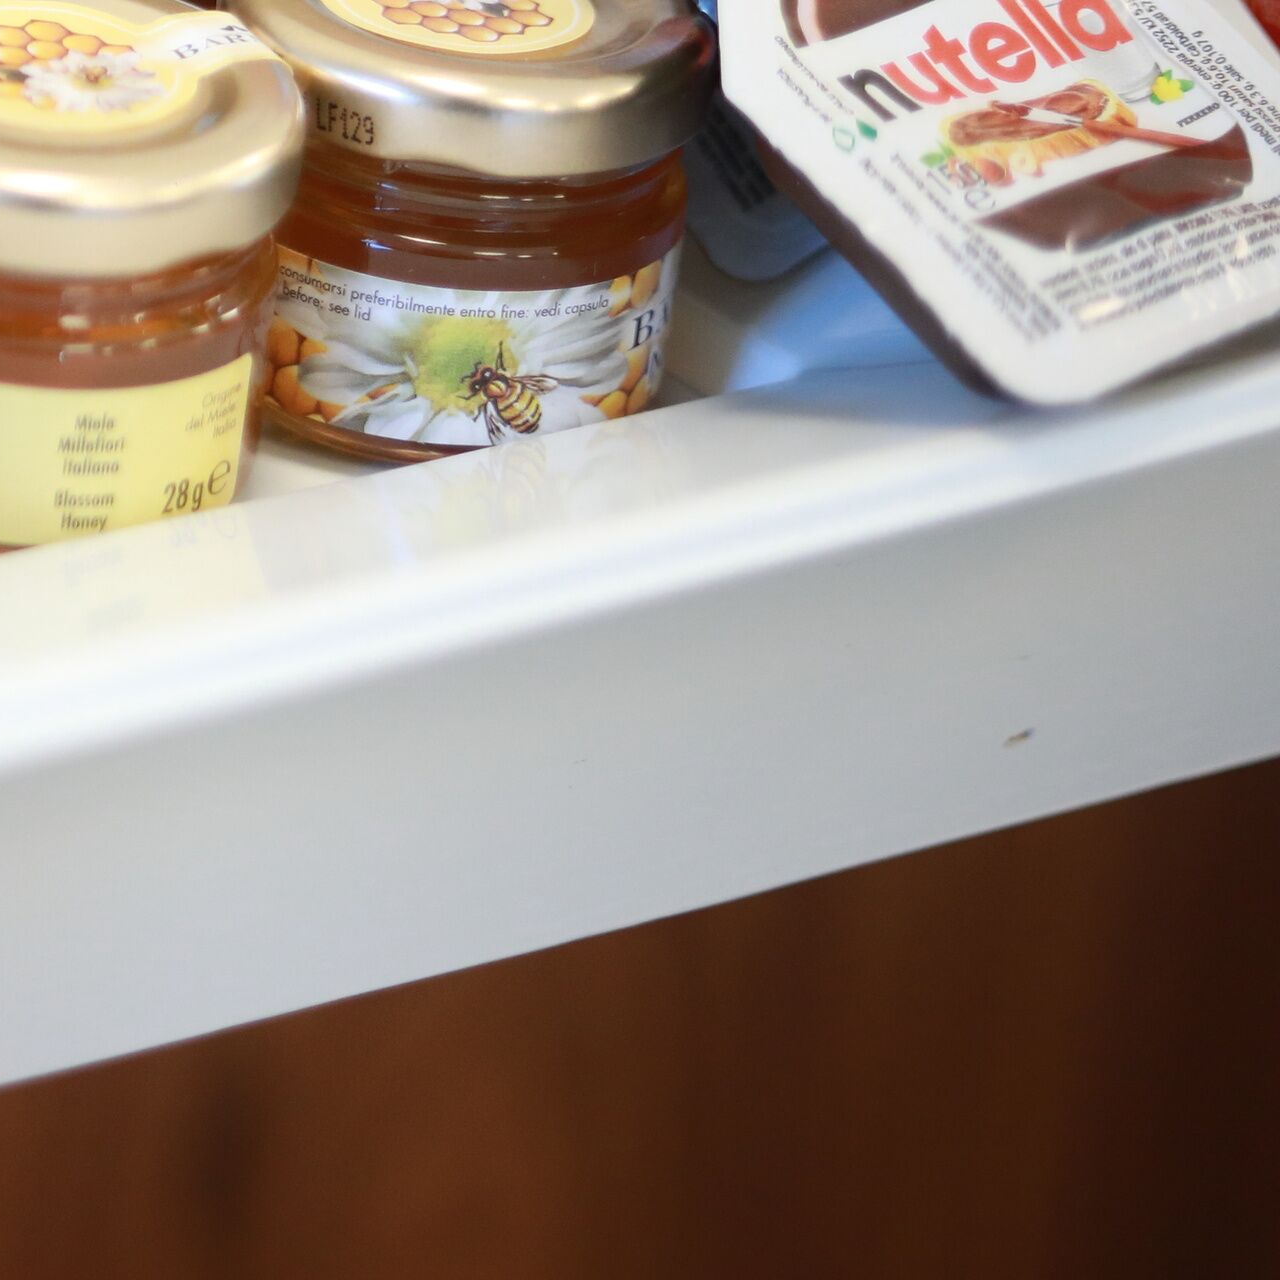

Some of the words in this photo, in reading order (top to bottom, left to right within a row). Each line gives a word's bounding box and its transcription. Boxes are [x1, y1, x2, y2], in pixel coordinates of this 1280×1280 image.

[1152, 28, 1179, 54] 2252
[1218, 89, 1238, 108] 100
[279, 264, 346, 297] consumarsi
[350, 288, 455, 317] preferibilmente
[459, 306, 496, 320] entro
[500, 303, 529, 320] fine:
[534, 302, 561, 319] vedi
[564, 296, 610, 318] capsula
[281, 285, 325, 310] before:
[327, 300, 350, 315] see
[352, 303, 372, 322] lid
[60, 513, 107, 533] Honey
